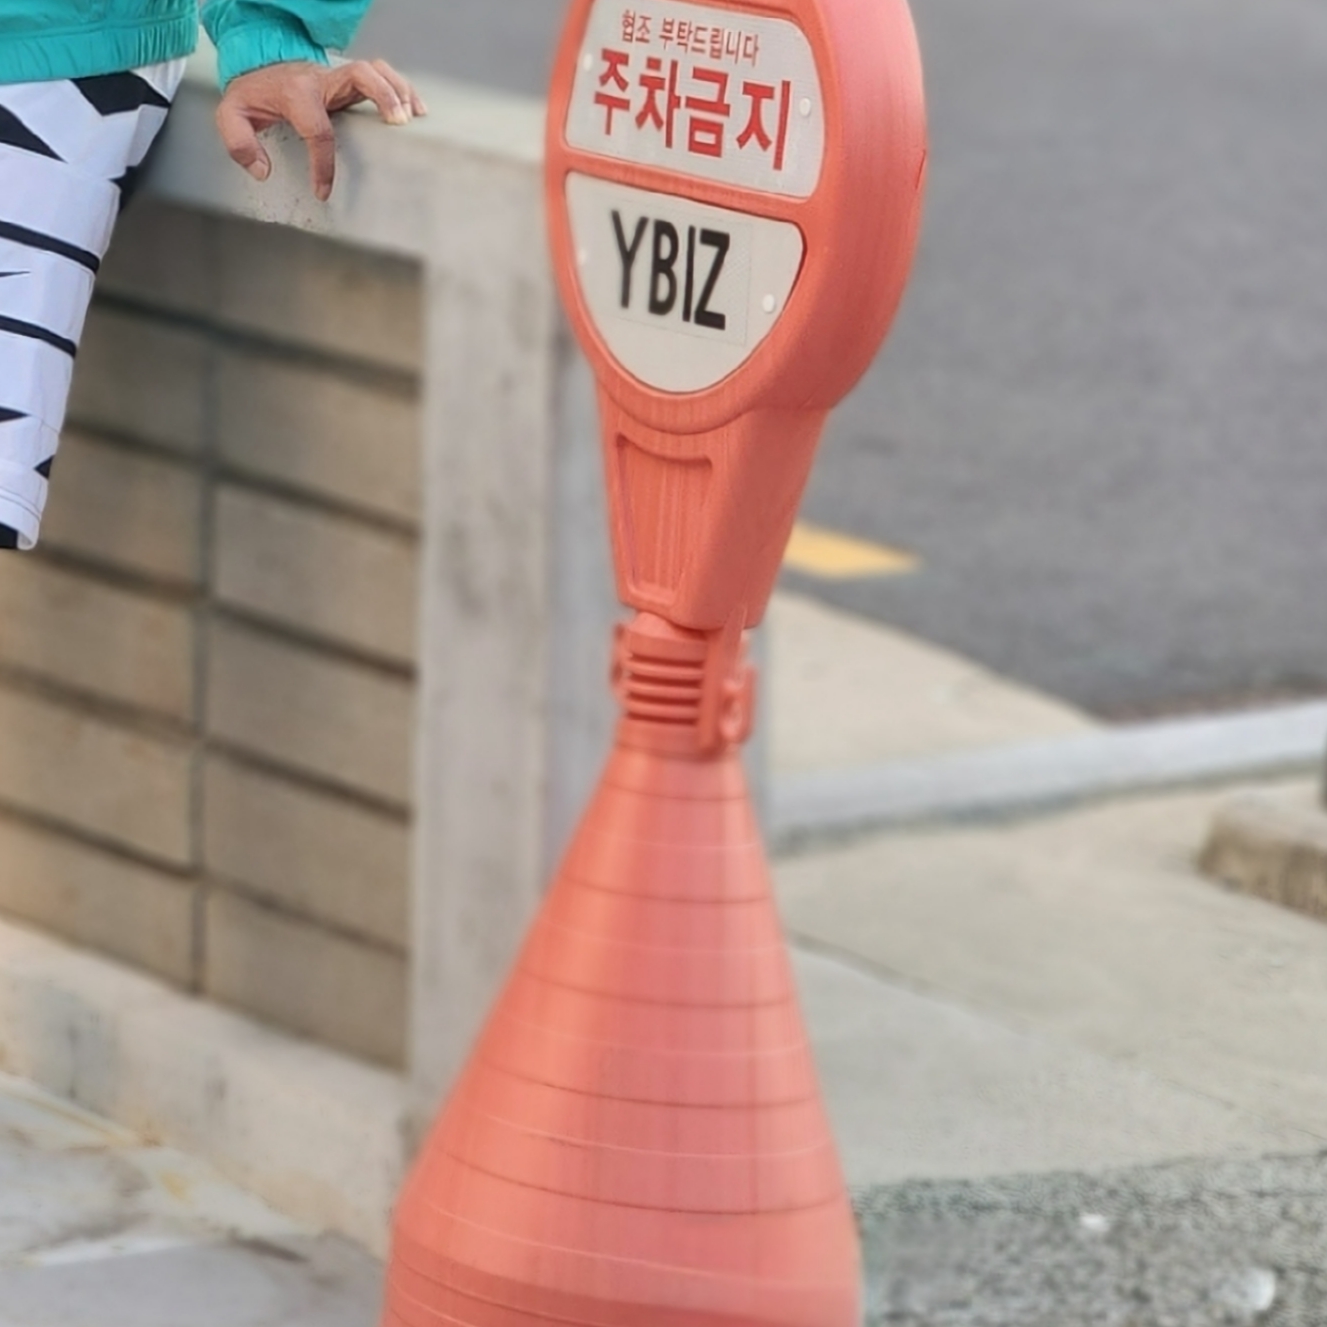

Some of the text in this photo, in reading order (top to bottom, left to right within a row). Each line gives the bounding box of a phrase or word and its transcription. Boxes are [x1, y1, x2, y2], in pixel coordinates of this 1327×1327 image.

[621, 9, 760, 67] 협조 부탁드립니다
[594, 48, 791, 171] 주차금지
[611, 209, 731, 331] YBIZ
